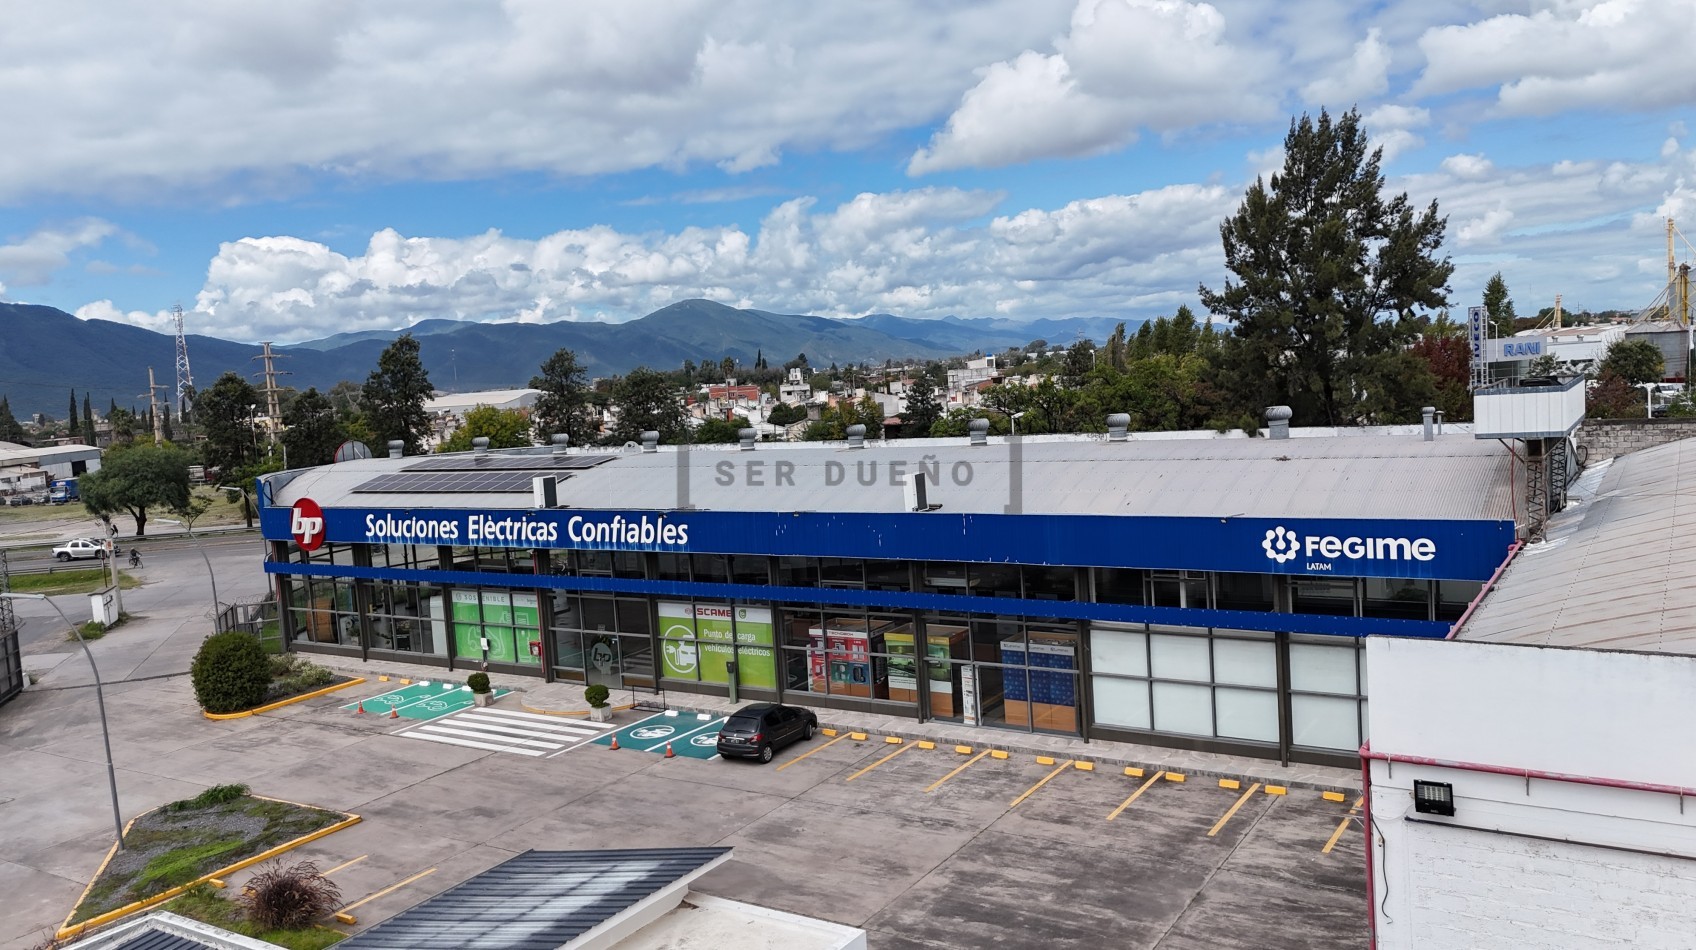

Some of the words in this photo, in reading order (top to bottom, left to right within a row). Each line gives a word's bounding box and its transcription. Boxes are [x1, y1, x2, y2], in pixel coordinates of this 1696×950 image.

[1503, 341, 1541, 357] RANI
[290, 507, 323, 545] bp
[365, 512, 459, 540] Soluciones
[568, 514, 689, 545] Confiables
[1306, 562, 1332, 571] LATAM
[464, 594, 505, 603] SOSENIBLE
[696, 607, 732, 618] SCAME
[703, 628, 723, 639] Punto
[724, 629, 734, 639] de
[737, 632, 756, 643] carga
[704, 643, 734, 654] vehículos
[737, 646, 771, 657] eléctricos
